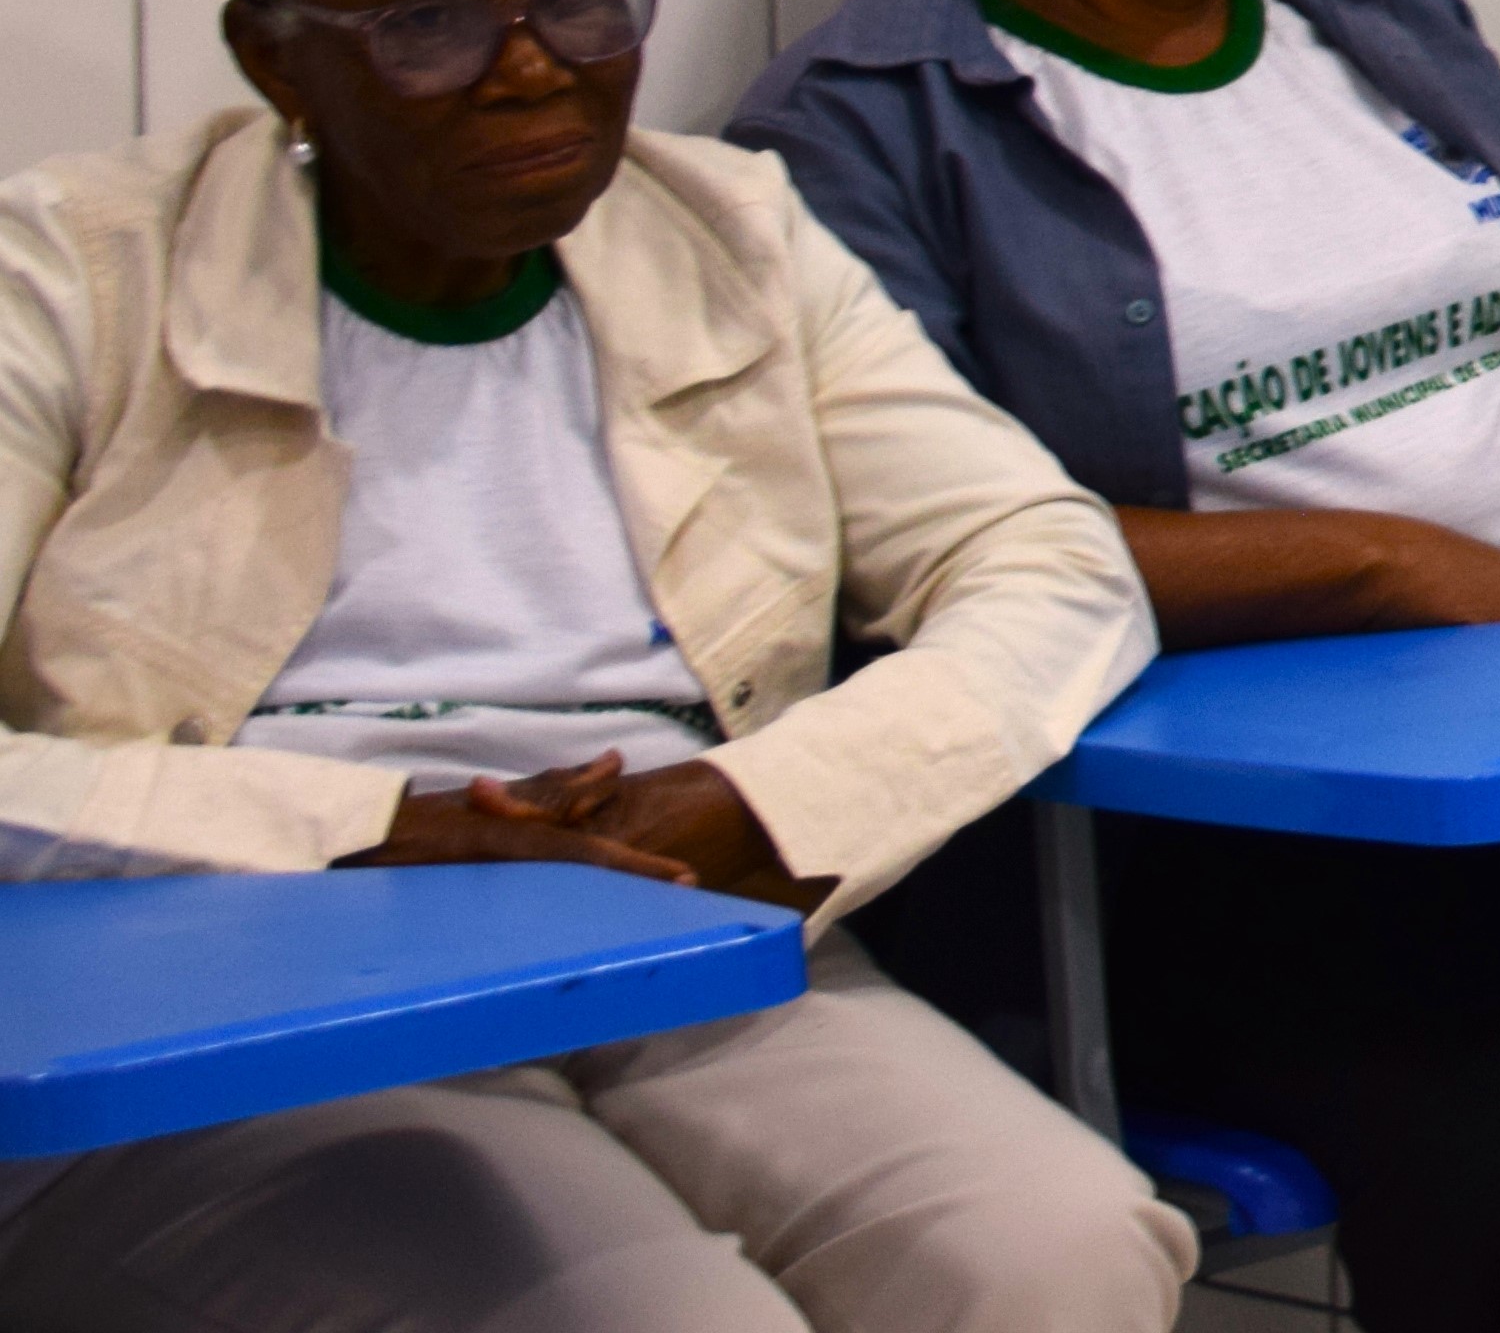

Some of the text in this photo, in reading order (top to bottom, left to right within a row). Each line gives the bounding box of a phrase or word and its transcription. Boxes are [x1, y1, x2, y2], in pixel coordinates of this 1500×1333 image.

[1289, 348, 1332, 403] DE
[1337, 310, 1438, 388] JOVENS
[1447, 302, 1461, 348] E
